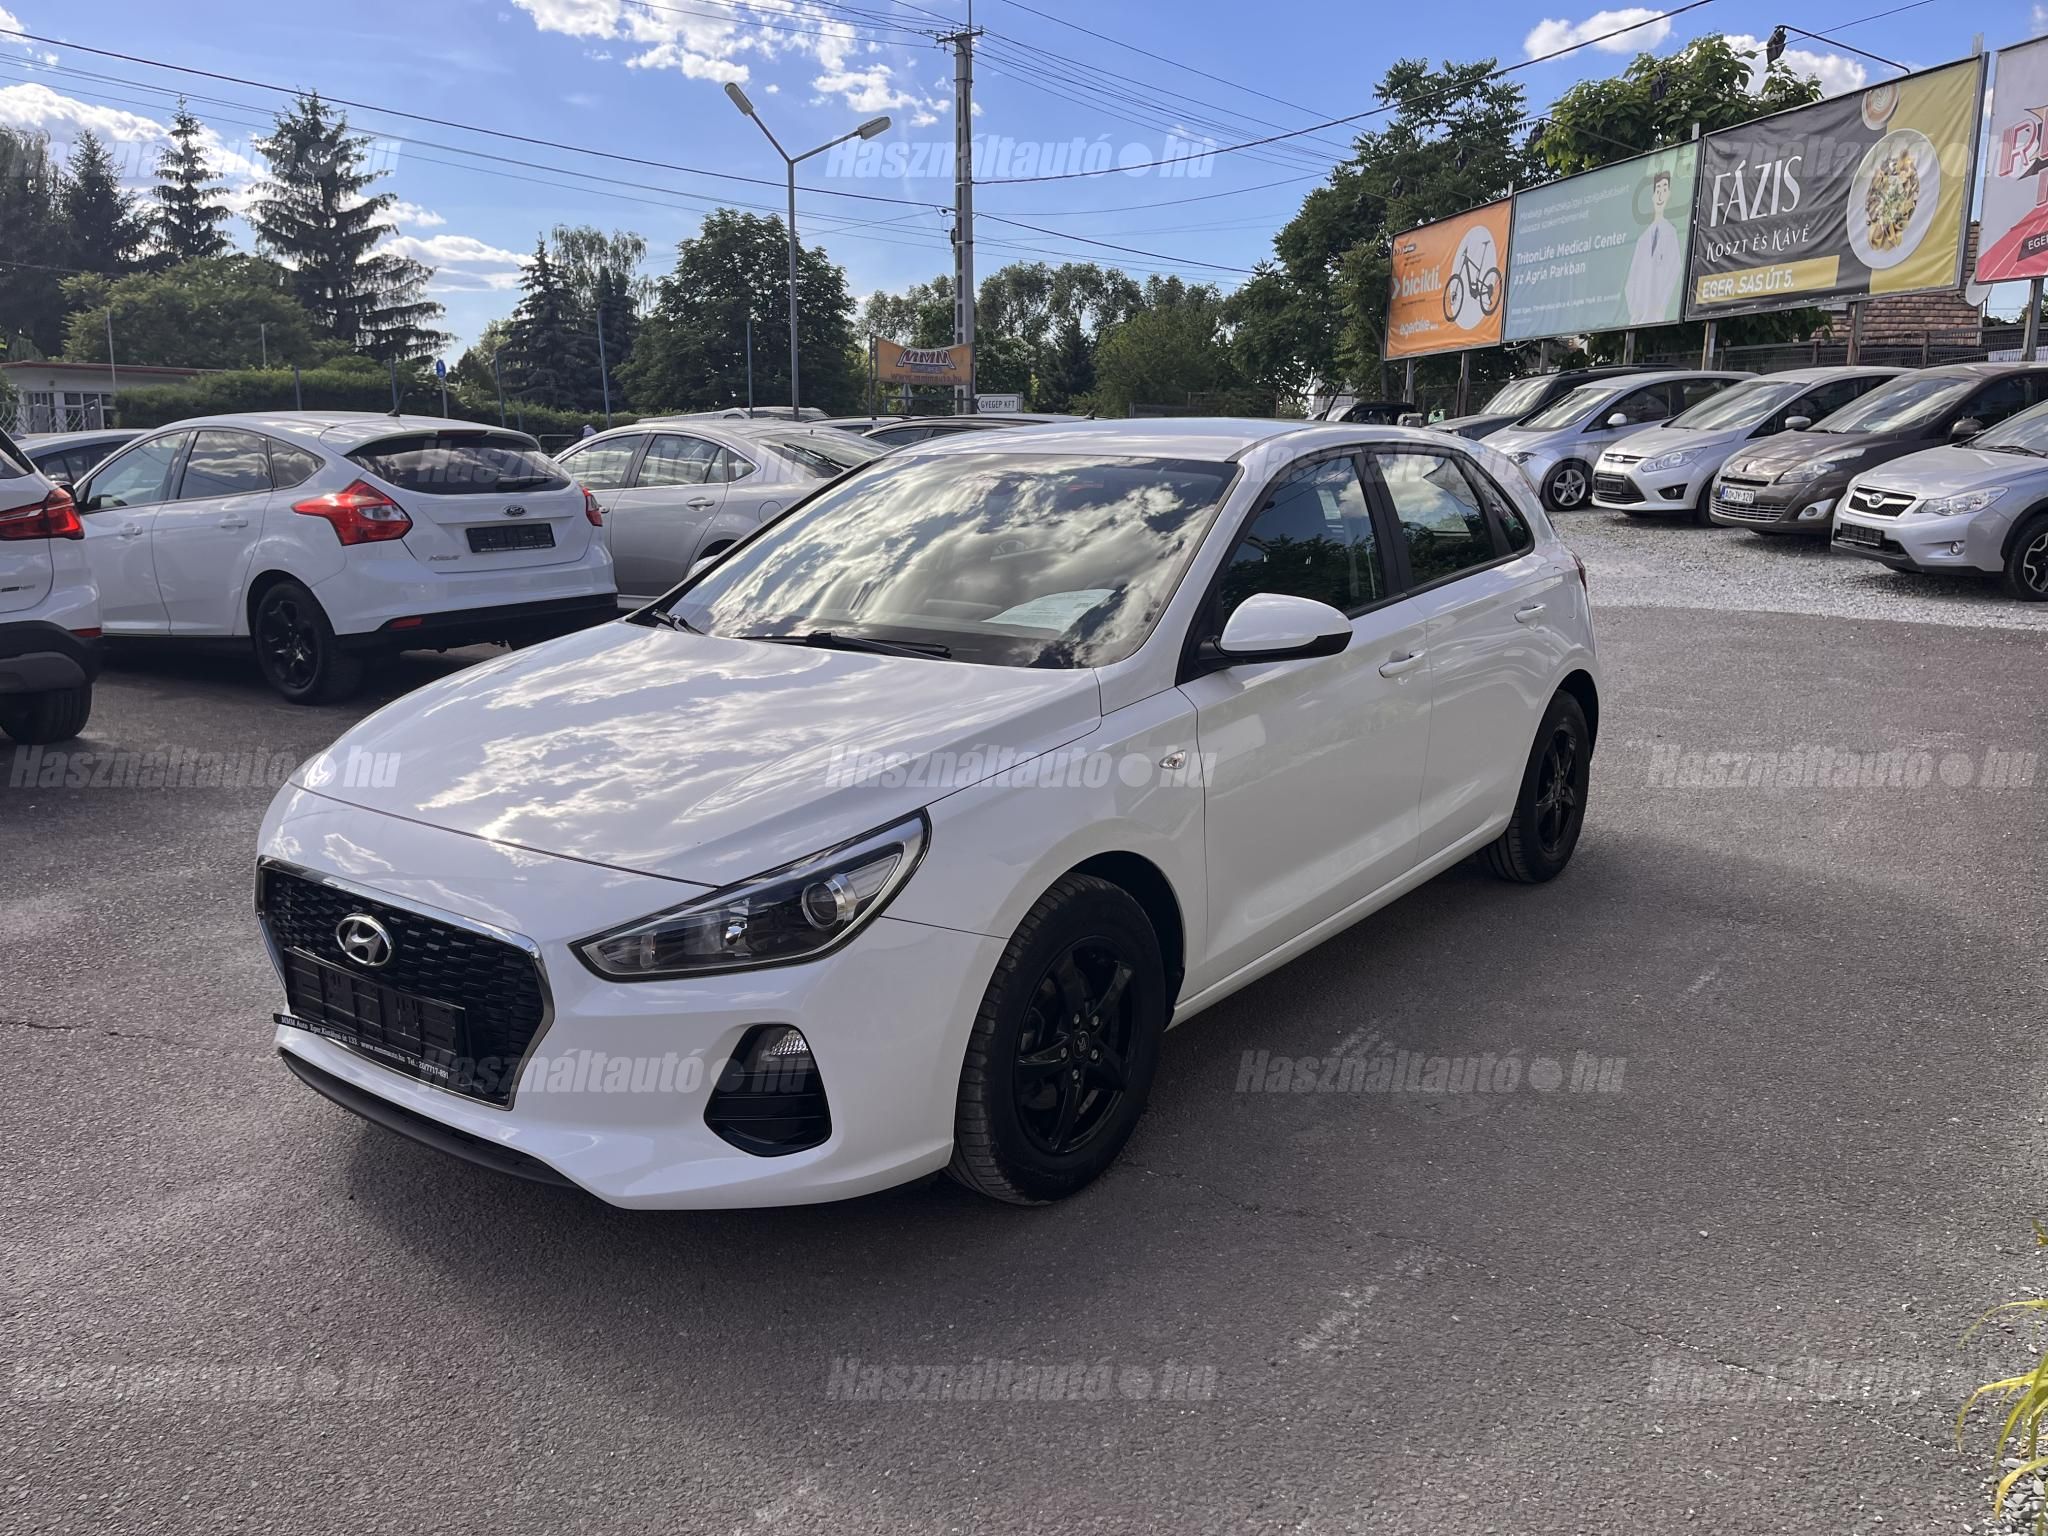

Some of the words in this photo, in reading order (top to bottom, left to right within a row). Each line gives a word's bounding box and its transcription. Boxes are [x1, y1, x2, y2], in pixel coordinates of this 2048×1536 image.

[1709, 155, 1802, 228] FÁZIS
[1516, 246, 1555, 266] TritonLife
[1556, 236, 1592, 258] Medical
[1594, 231, 1627, 249] Center
[1706, 238, 1749, 263] KOSZT
[1752, 233, 1768, 251] ÉS
[1771, 223, 1810, 252] KÁVÉ
[1402, 264, 1443, 298] bicikli.
[1524, 266, 1548, 285] Agria
[1549, 261, 1586, 279] Parkban
[1702, 278, 1735, 299] EGER,
[1737, 274, 1763, 295] SAS
[1765, 267, 1785, 289] ÚT
[896, 348, 957, 370] MMM
